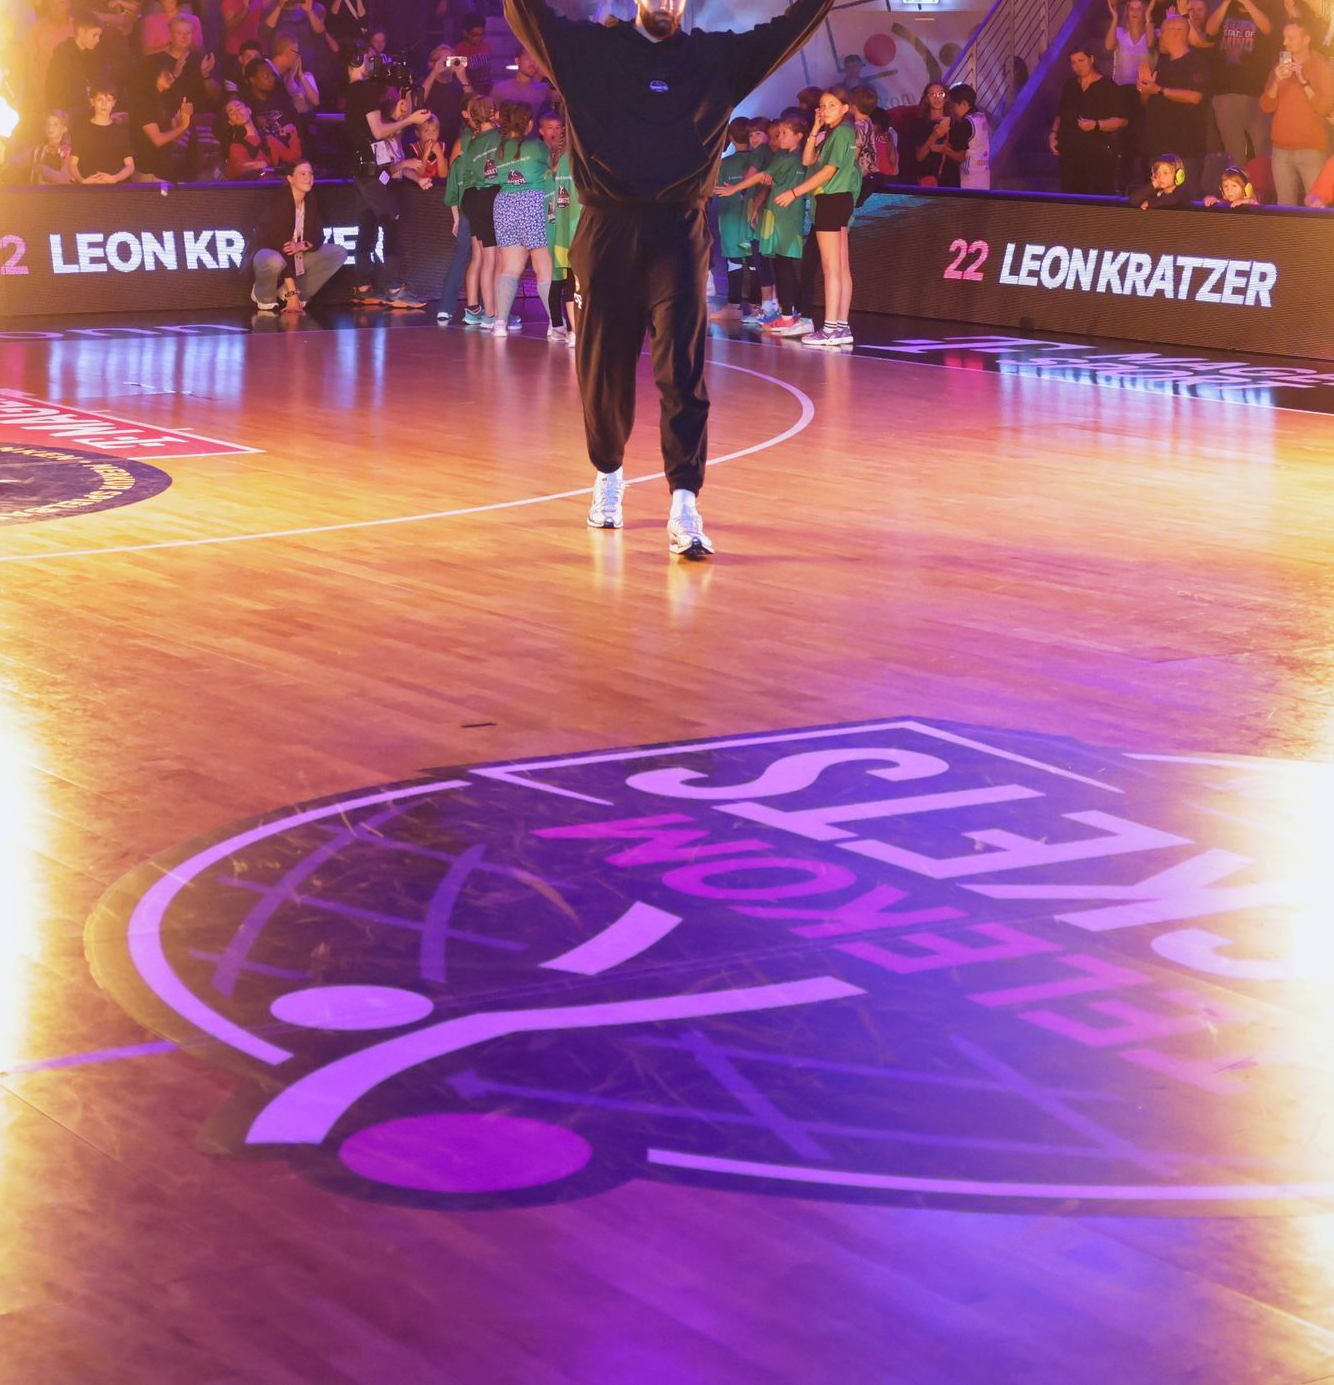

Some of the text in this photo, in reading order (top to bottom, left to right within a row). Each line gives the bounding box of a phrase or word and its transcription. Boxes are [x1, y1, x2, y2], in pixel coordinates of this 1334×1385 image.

[49, 230, 180, 276] LEON
[942, 238, 1278, 309] 22 LEON KRATZER
